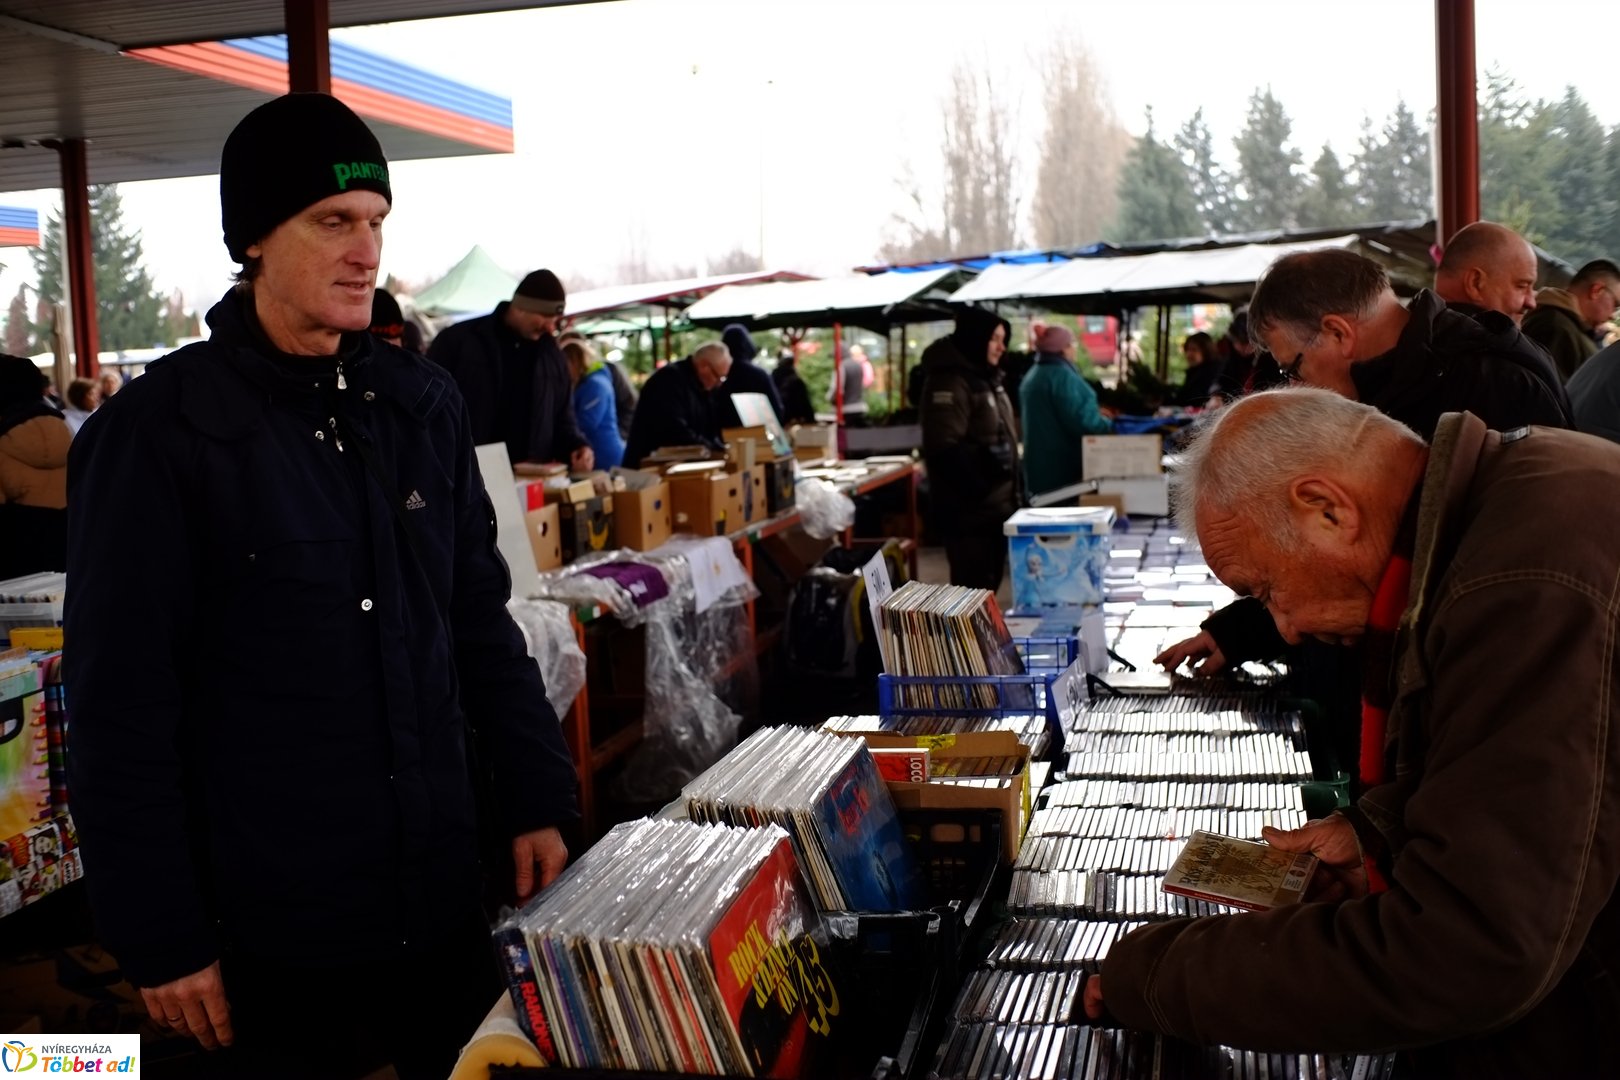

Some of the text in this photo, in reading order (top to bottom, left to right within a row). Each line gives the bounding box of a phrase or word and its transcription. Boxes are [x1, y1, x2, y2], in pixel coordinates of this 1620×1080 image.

[333, 162, 389, 190] PANTE
[728, 919, 769, 989] ROCK
[778, 933, 840, 1037] ON 45
